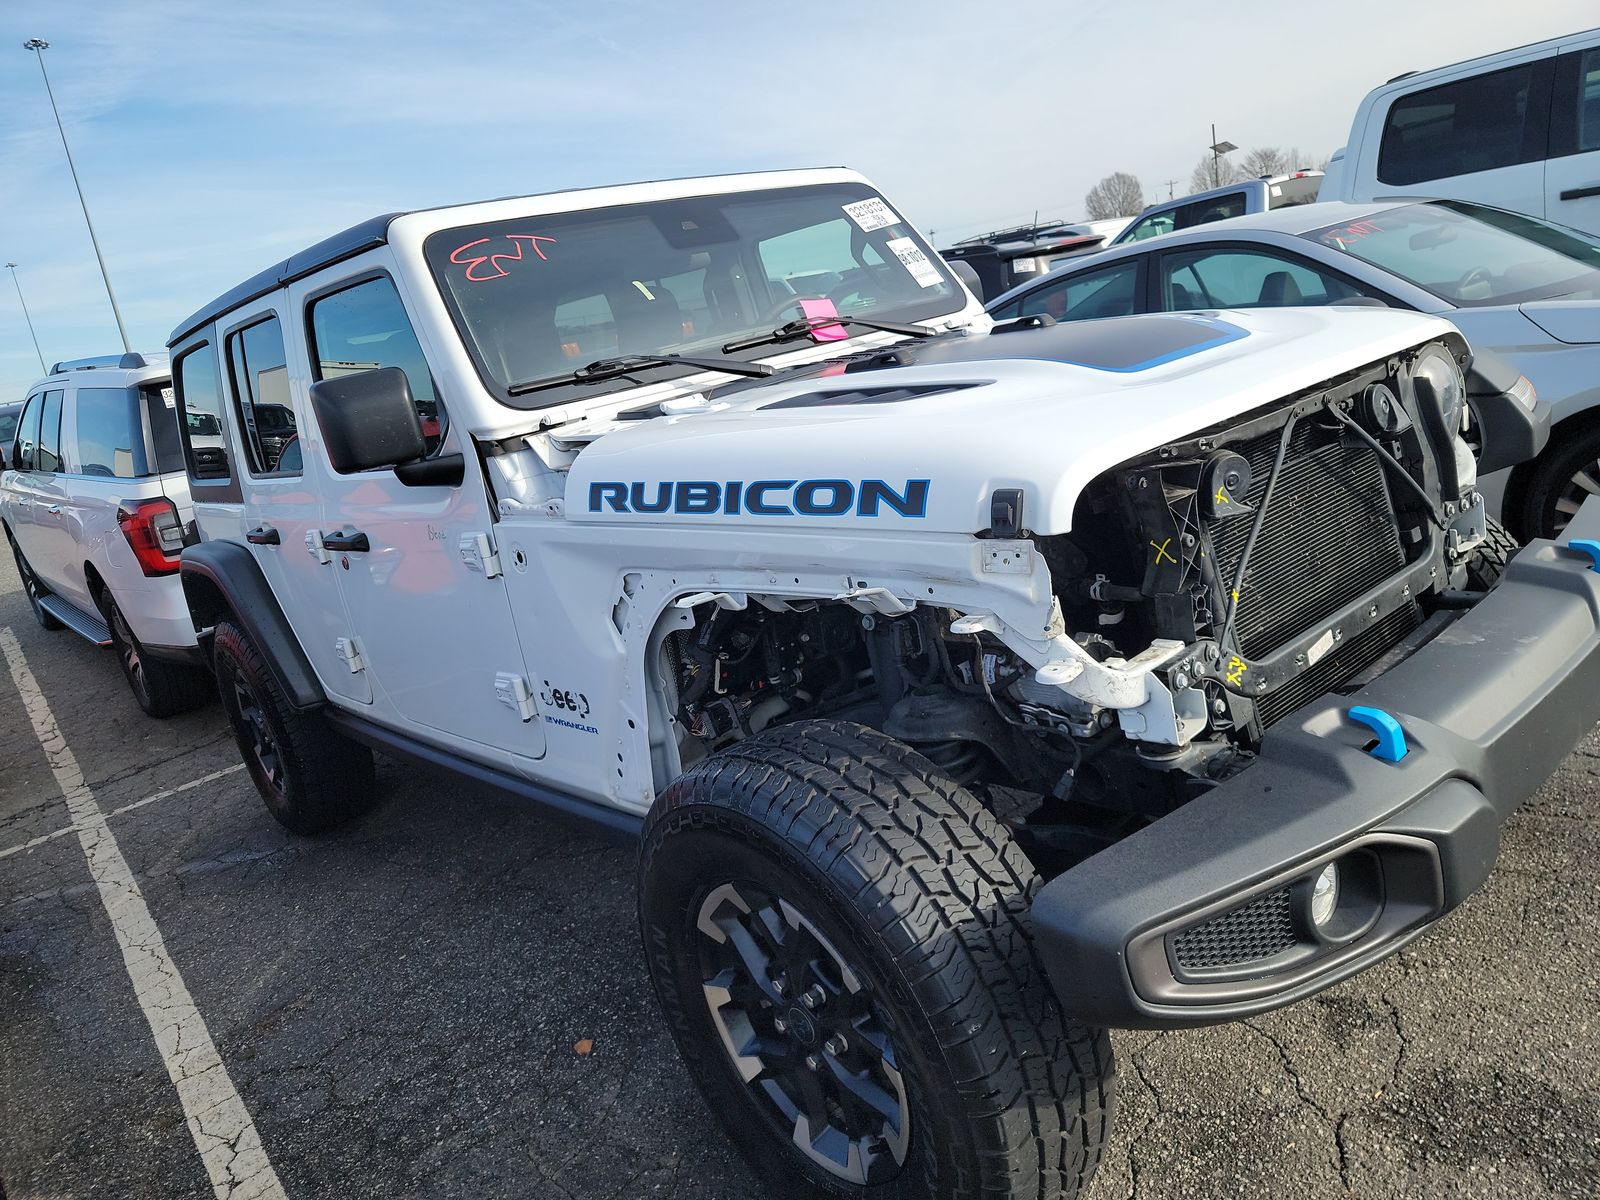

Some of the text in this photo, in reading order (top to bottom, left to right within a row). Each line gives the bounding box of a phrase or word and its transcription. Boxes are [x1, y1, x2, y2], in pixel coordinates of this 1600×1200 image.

[449, 234, 558, 282] ENT
[588, 479, 932, 518] RUBICON
[552, 717, 599, 734] WRANGLER
